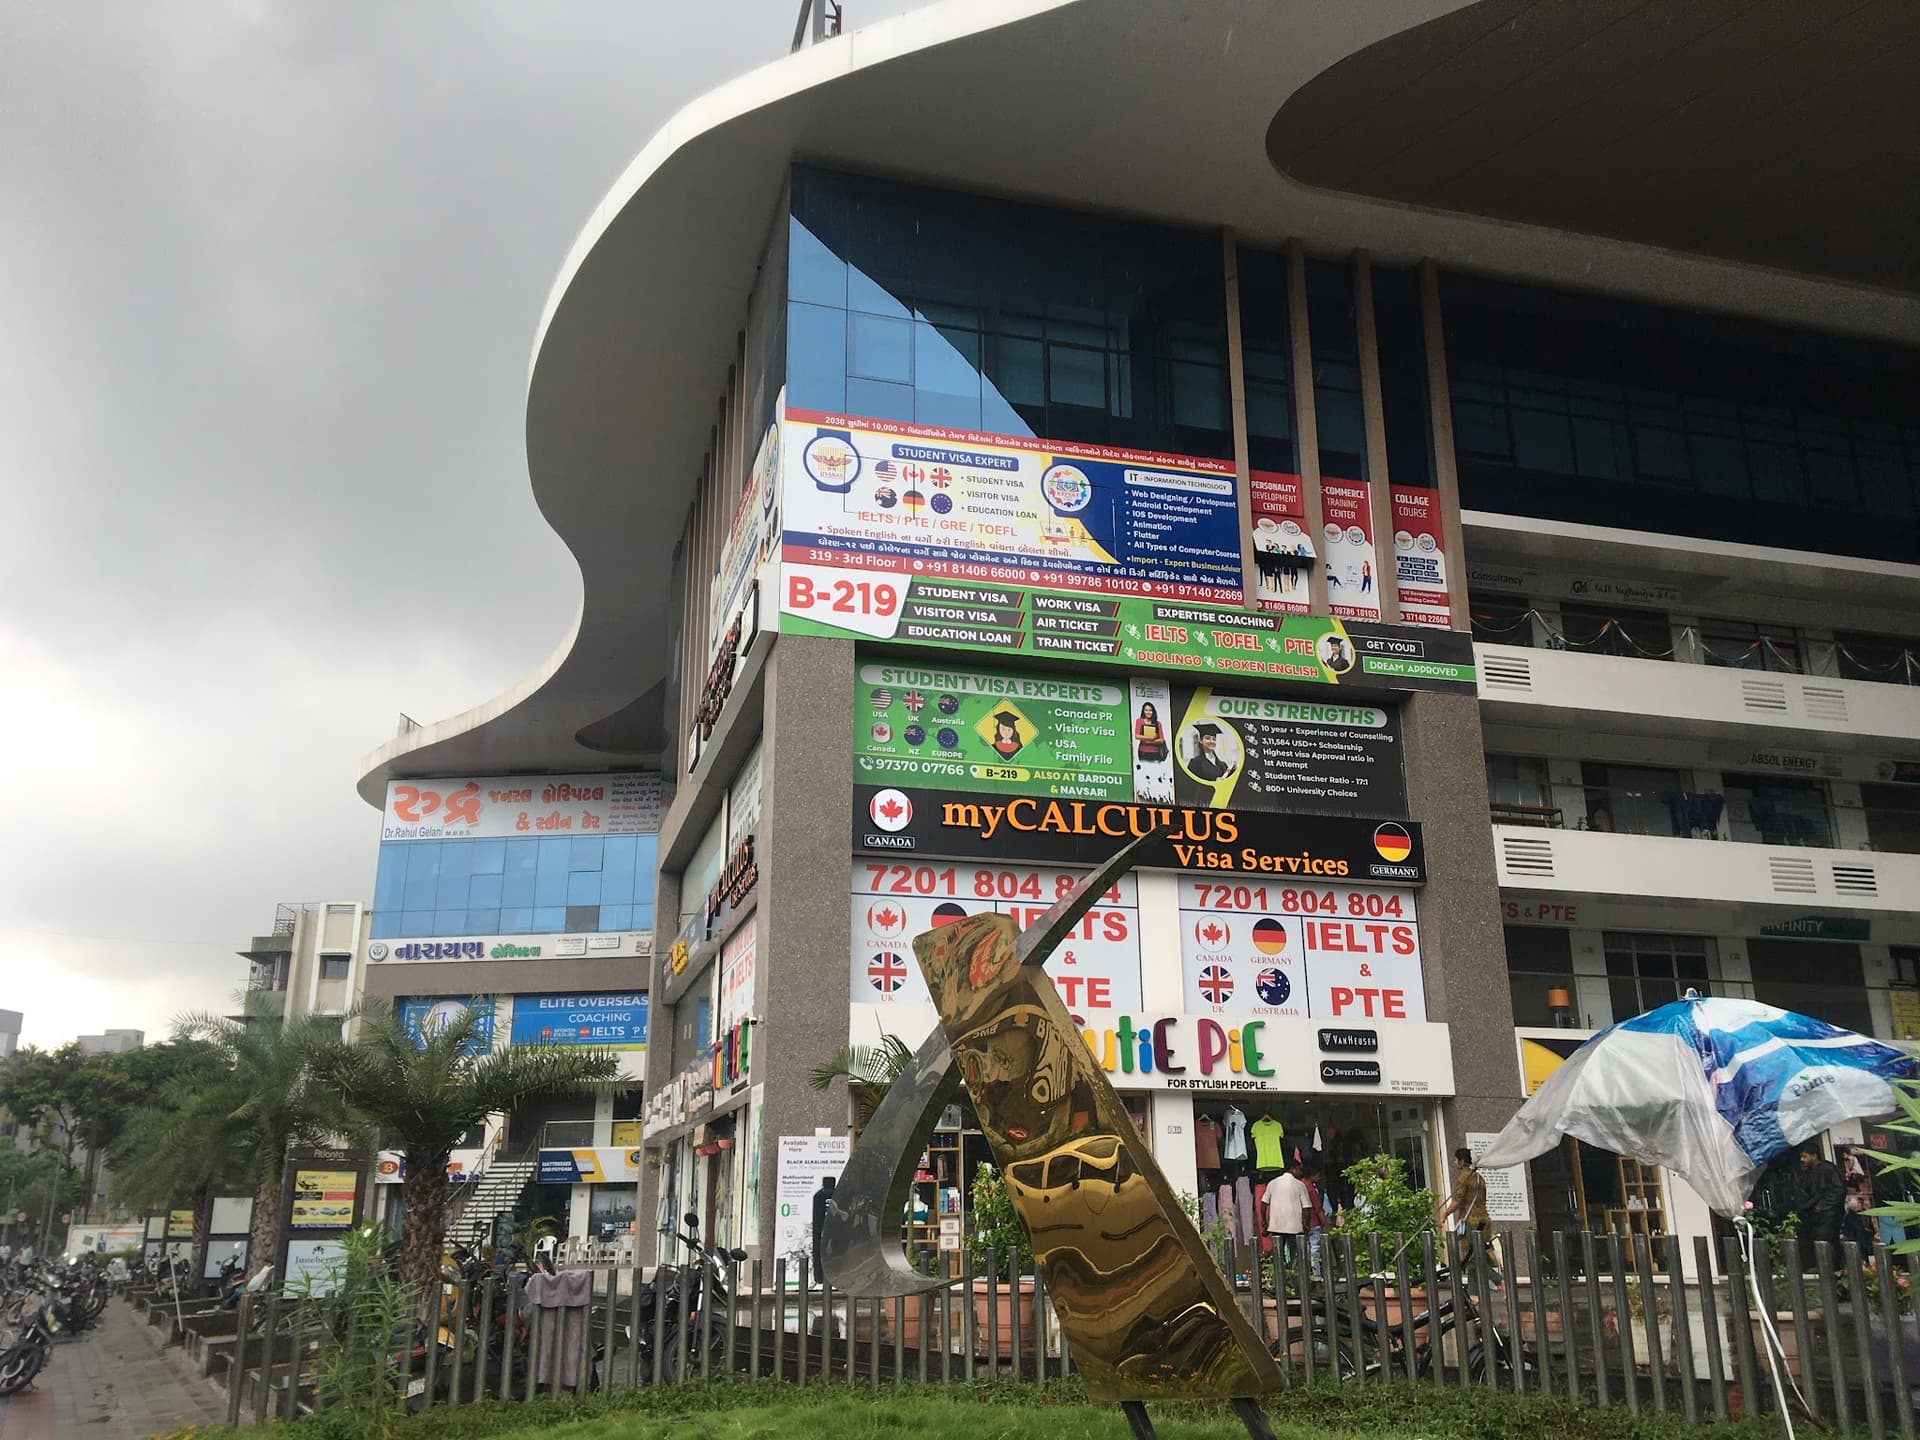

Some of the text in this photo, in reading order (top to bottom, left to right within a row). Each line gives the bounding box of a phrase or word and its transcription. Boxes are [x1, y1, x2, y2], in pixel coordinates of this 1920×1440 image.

[898, 448, 1012, 468] STUDENT VISA EXPERT
[966, 476, 1024, 488] STUDENT VISA
[1130, 473, 1138, 482] IT
[1252, 480, 1296, 493] PERSONALITY
[967, 490, 1020, 502] VISITOR VISA
[1132, 490, 1188, 504] Web Designing
[1252, 492, 1296, 504] DEVELOPMENT
[1395, 493, 1430, 506] COLLAGE
[1132, 500, 1212, 516] Android Development
[1263, 502, 1287, 513] CENTER
[1328, 498, 1358, 509] TRAINING
[968, 506, 1037, 520] EDUCATION LOAN
[1148, 512, 1198, 524] Development
[1330, 508, 1356, 520] CENTER
[1399, 506, 1428, 518] COURSE
[858, 511, 1018, 536] IELTS PTE GRE TOEFL
[1133, 521, 1172, 531] Animation
[827, 526, 862, 536] Spoken
[864, 530, 897, 541] English
[954, 539, 986, 550] English
[1134, 531, 1160, 540] Flutter
[810, 550, 1242, 601] 319 3rd Floor +91 81406 66000 +91 99786 10102 +91 97140 22669
[1472, 570, 1523, 586] Consultancy
[789, 576, 898, 617] B-219
[918, 586, 1008, 604] STUDENT VISA
[1036, 598, 1101, 613] WORK VISA
[914, 606, 997, 622] VISITOR VISA
[1157, 608, 1274, 629] EXPERTISE COACHING
[1037, 618, 1098, 632] AIR TICKET
[908, 626, 1012, 644] EDUCATION LOAN
[1144, 624, 1314, 656] IELTS TOFEL PTE
[1037, 637, 1114, 653] TRAIN TICKET
[1366, 640, 1416, 654] GET YOUR
[1137, 650, 1319, 678] DUOLINGO SPOKEN ENGLISH
[1370, 661, 1458, 677] DREAM APPROVED
[882, 668, 1102, 701] STUDENT VISA EXPERTS
[872, 710, 888, 718] USA
[1054, 708, 1112, 722] Canada PR
[1218, 699, 1375, 725] OUR STRENGTHS
[932, 716, 965, 726] Australia
[1054, 723, 1116, 737] Visitor Visa
[1296, 728, 1394, 743] Experience Counselling
[867, 744, 896, 753] Canada
[1056, 740, 1077, 750] USA
[1318, 740, 1364, 752] Scholarship
[932, 750, 963, 760] EUROPE
[1056, 752, 1113, 766] Family File
[1263, 748, 1364, 763] Highest Approval ratio
[1752, 754, 1818, 768] ABSOL ENERGY
[876, 758, 964, 776] 97370 07766
[1276, 760, 1308, 770] Attempt
[986, 768, 1018, 780] B-219
[1034, 772, 1122, 785] ALSO AT BARDOLI
[1264, 772, 1350, 784] Student Teacher Ratio
[1050, 786, 1107, 797] & NAVSARI
[1266, 784, 1358, 798] 800+ University Choices
[516, 812, 530, 831] &
[942, 798, 1239, 843] myCALCULUS
[866, 836, 912, 847] CANADA
[1172, 844, 1350, 877] Visa Services
[1373, 866, 1416, 876] GERMANY
[866, 864, 1121, 904] 7201 804 84
[1194, 884, 1403, 918] 7201 804 804
[1524, 904, 1576, 922] & PTE
[867, 940, 908, 949] CANADA
[1306, 922, 1416, 955] IELTS
[394, 942, 484, 960] નારાયણ
[1064, 951, 1076, 964] &
[1196, 954, 1232, 962] CANADA
[1250, 956, 1292, 966] GERMANY
[1360, 964, 1372, 977] &
[881, 994, 894, 1002] UK
[1048, 976, 1112, 1008] TE
[540, 996, 648, 1008] ELITE OVERSEAS
[1331, 986, 1406, 1019] PTE
[1212, 1006, 1224, 1014] UK
[1252, 1007, 1299, 1016] AUSTRALIA
[568, 1012, 631, 1023] COACHING
[592, 1026, 625, 1036] IELTS
[1168, 1079, 1278, 1091] FOR STYLISH PEOPLE....
